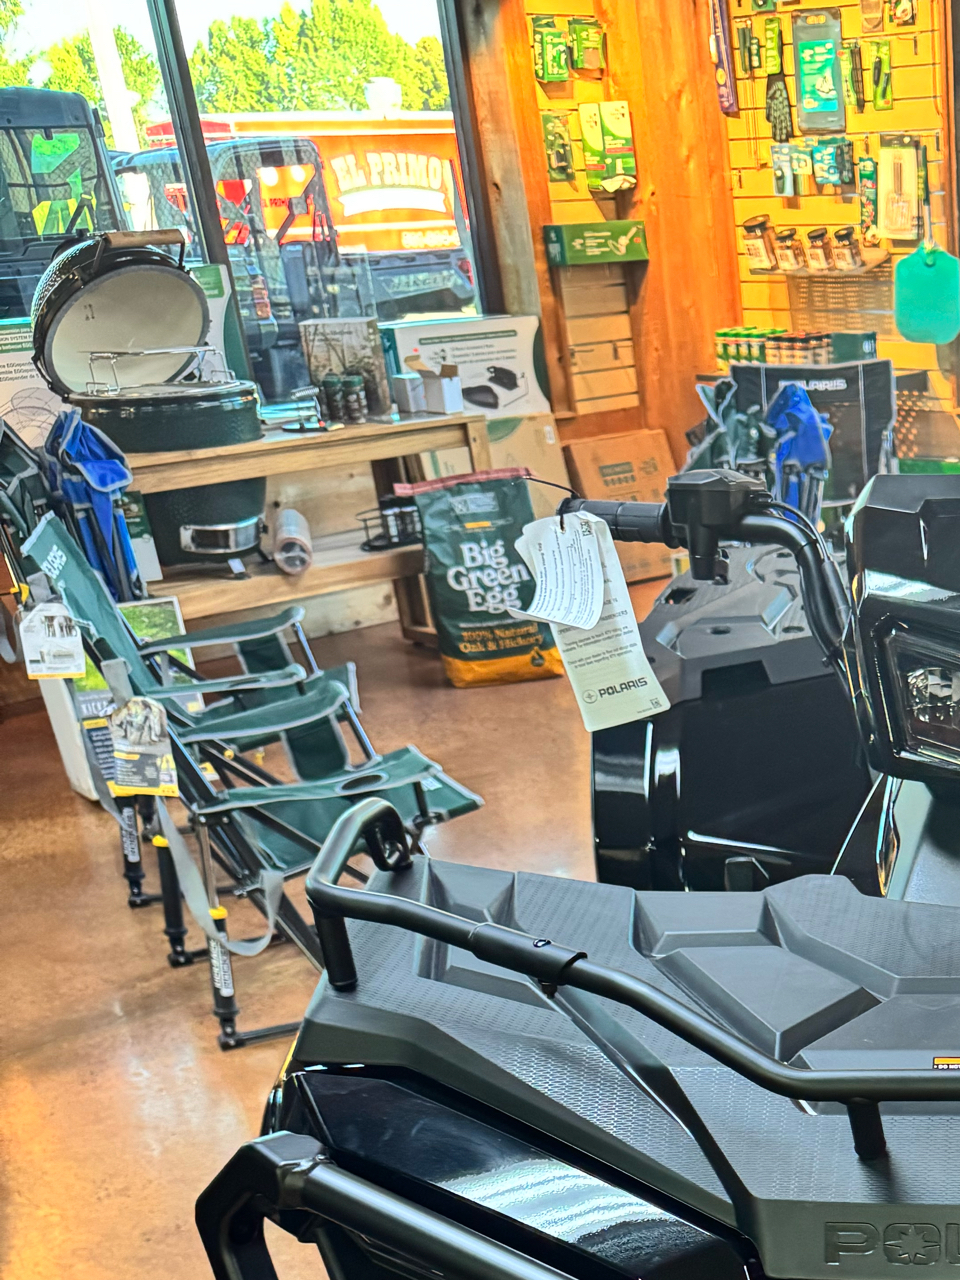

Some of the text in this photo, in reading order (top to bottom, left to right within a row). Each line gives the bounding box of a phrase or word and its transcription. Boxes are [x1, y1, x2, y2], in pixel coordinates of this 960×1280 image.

[331, 152, 443, 191] EL PRIMO
[459, 539, 509, 569] Big
[446, 563, 531, 592] Green
[466, 583, 522, 614] Egg
[458, 642, 486, 653] Oak
[598, 677, 648, 698] POLARIS
